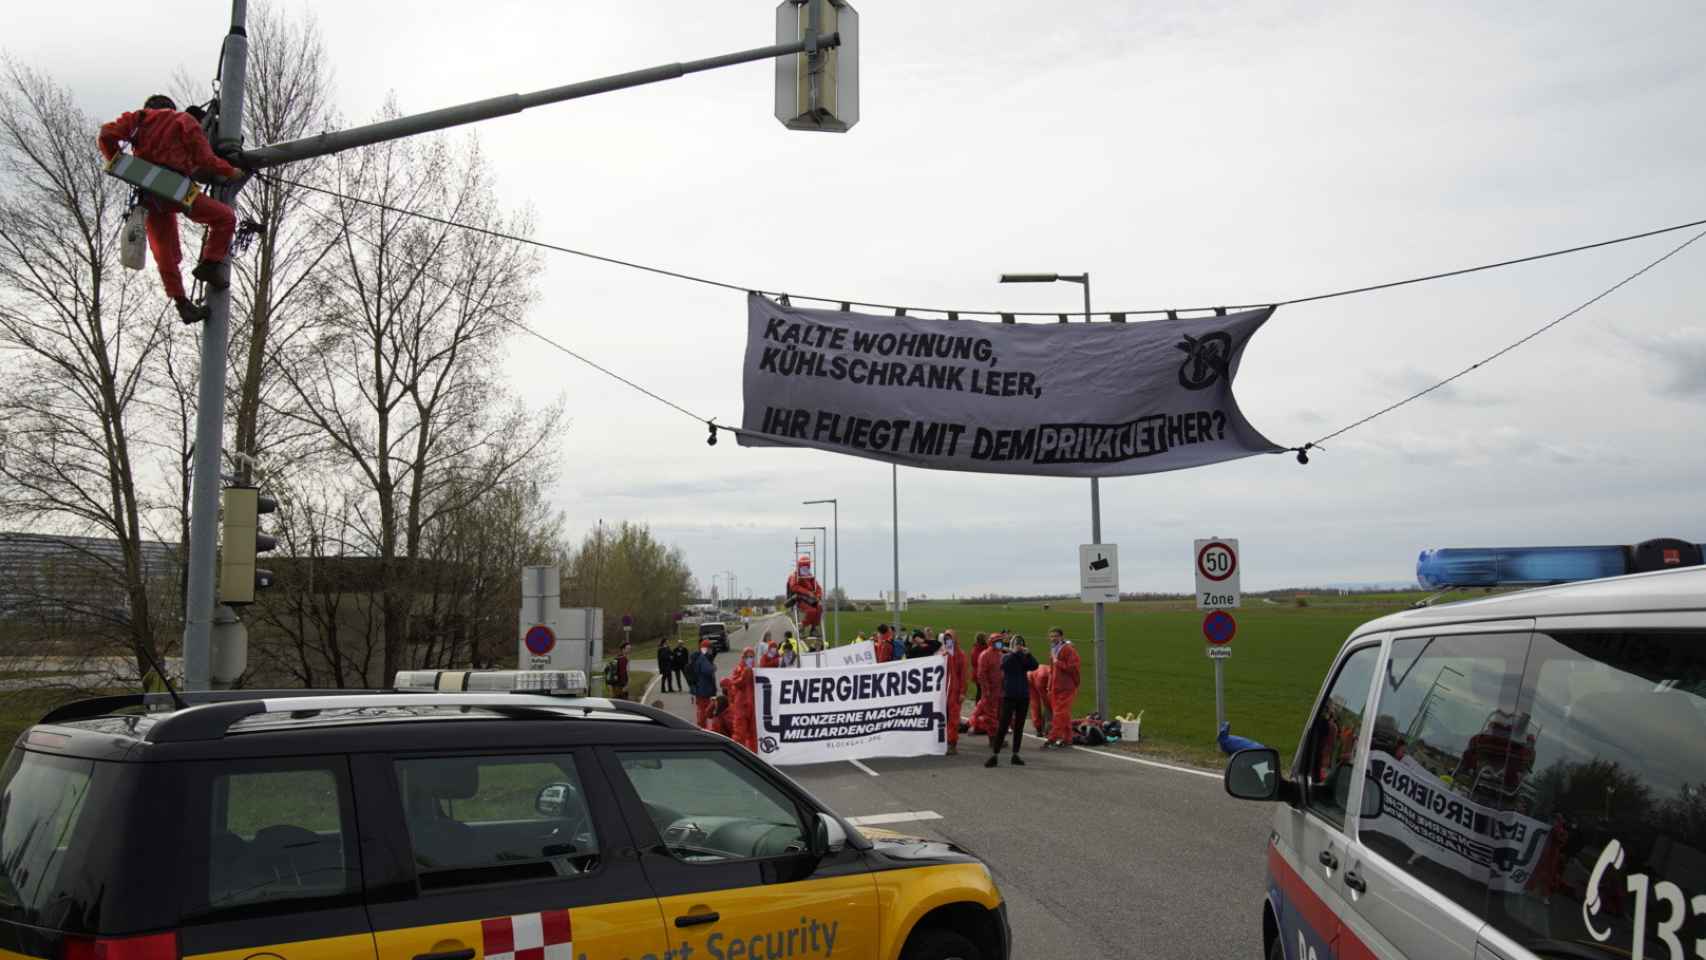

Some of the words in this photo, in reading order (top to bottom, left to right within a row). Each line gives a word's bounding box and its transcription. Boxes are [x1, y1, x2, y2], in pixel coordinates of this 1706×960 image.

[763, 318, 849, 349] KALTE
[852, 330, 998, 367] WOHNUNG,
[760, 345, 964, 391] KÜHLSCHRANK
[970, 369, 1042, 399] LEER,
[761, 407, 811, 439] IHR
[812, 410, 910, 451] FLIEGT
[910, 421, 966, 456] MIT
[970, 427, 1036, 461] DEM
[1036, 415, 1167, 461] PRIVATJET
[1167, 409, 1226, 448] HER?
[1206, 552, 1228, 572] 50
[1203, 592, 1234, 605] Zone
[779, 665, 945, 704] ENERGIEKRISE?
[783, 717, 929, 740] MILLIARDENGEWINNE!
[791, 711, 863, 726] KONZERNE
[865, 704, 923, 720] MACHEN
[707, 915, 838, 960] Security
